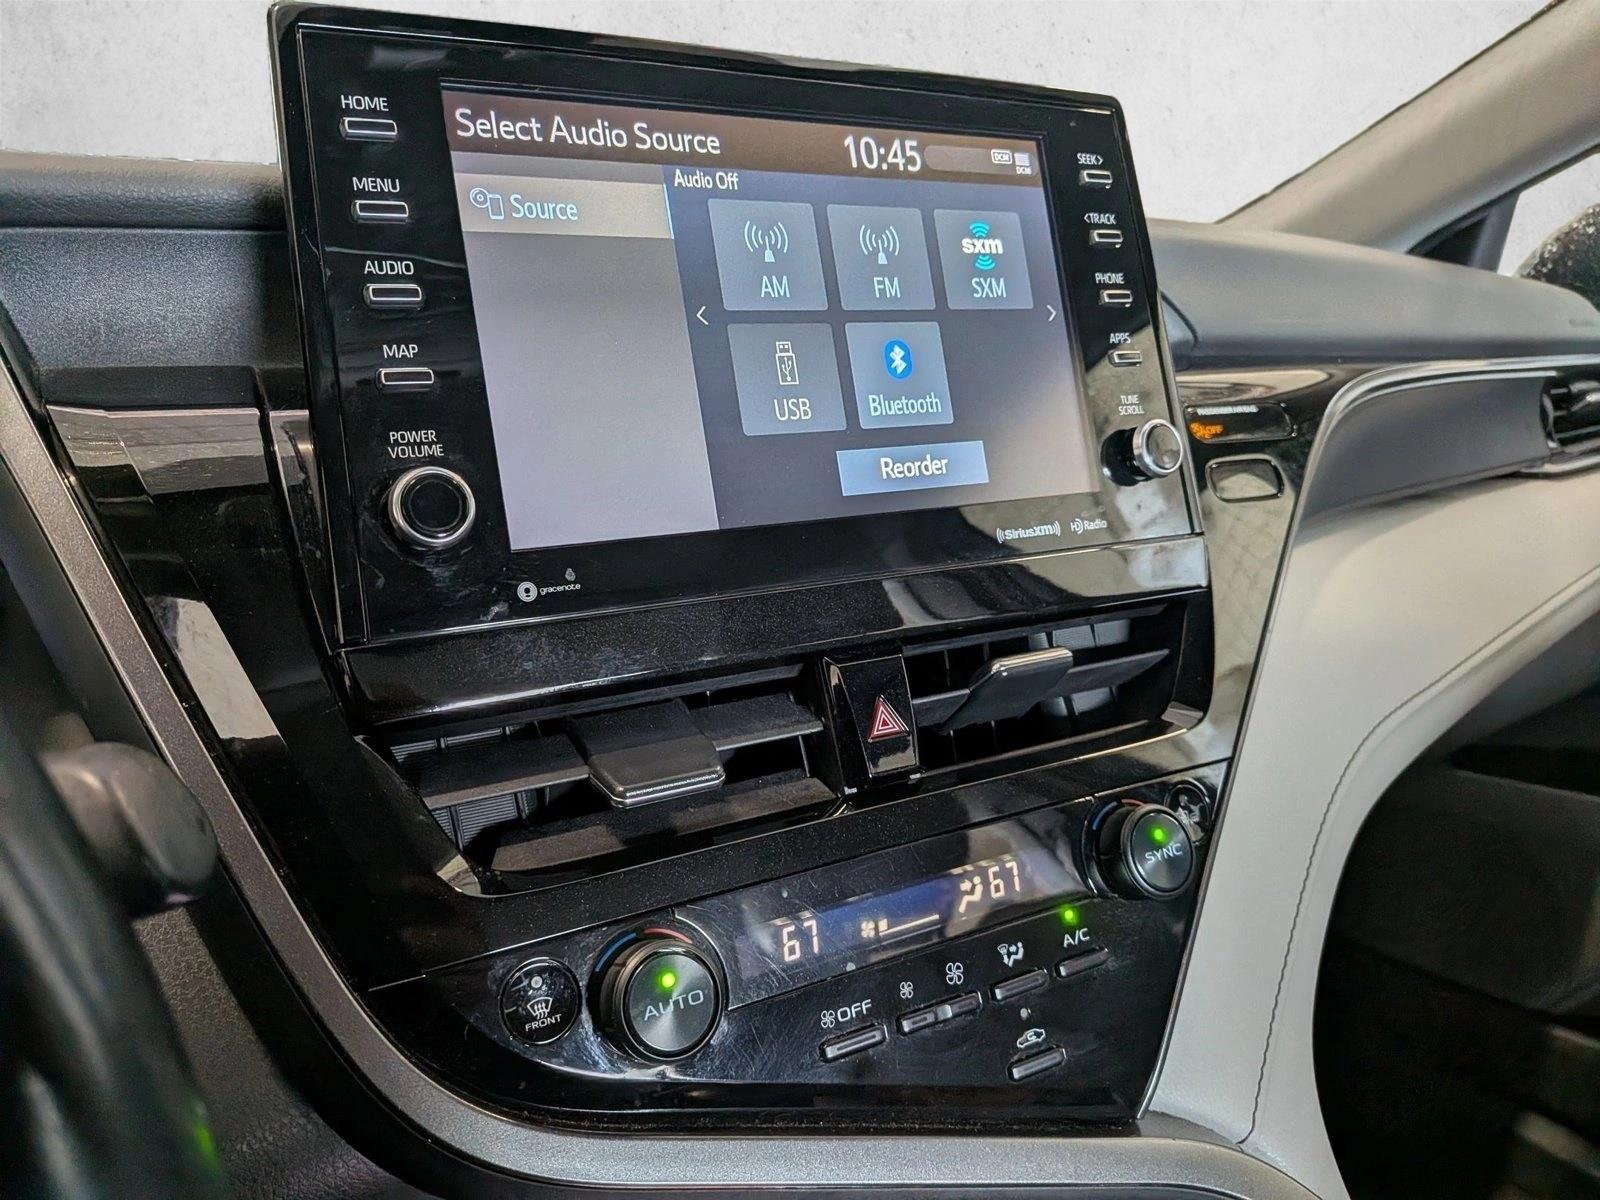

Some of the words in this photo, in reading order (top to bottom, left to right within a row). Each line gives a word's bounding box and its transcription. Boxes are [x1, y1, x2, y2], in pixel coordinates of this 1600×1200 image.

[341, 95, 388, 111] HOME
[455, 108, 542, 142] Select
[550, 115, 627, 148] Audio
[635, 123, 721, 154] Source
[843, 135, 922, 172] 10:45
[353, 177, 400, 193] MENU
[674, 169, 713, 189] Audio
[715, 172, 739, 190] Off
[510, 196, 578, 221] Source
[961, 236, 1003, 255] sxm
[364, 260, 415, 276] AUDIO
[760, 275, 790, 299] AM
[873, 277, 901, 299] FM
[971, 278, 1006, 299] SXM
[1095, 272, 1125, 285] PHONE
[1109, 333, 1131, 344] APPS
[383, 344, 418, 359] MAP
[774, 398, 812, 422] USB
[868, 392, 942, 418] Bluetooth
[1120, 395, 1139, 405] TUNE
[1118, 405, 1145, 416] SCROLL
[389, 430, 437, 444] POWER
[388, 444, 444, 459] VOLUME
[880, 454, 948, 481] Reorder
[1084, 519, 1107, 531] Radio
[540, 583, 581, 596] gracenote
[1144, 843, 1183, 864] SYNC
[988, 860, 1020, 899] 67
[782, 919, 819, 963] 67
[1063, 928, 1090, 948] A/C
[643, 989, 704, 1021] AUTO
[837, 999, 872, 1022] OFF
[525, 1013, 562, 1032] FRONT
